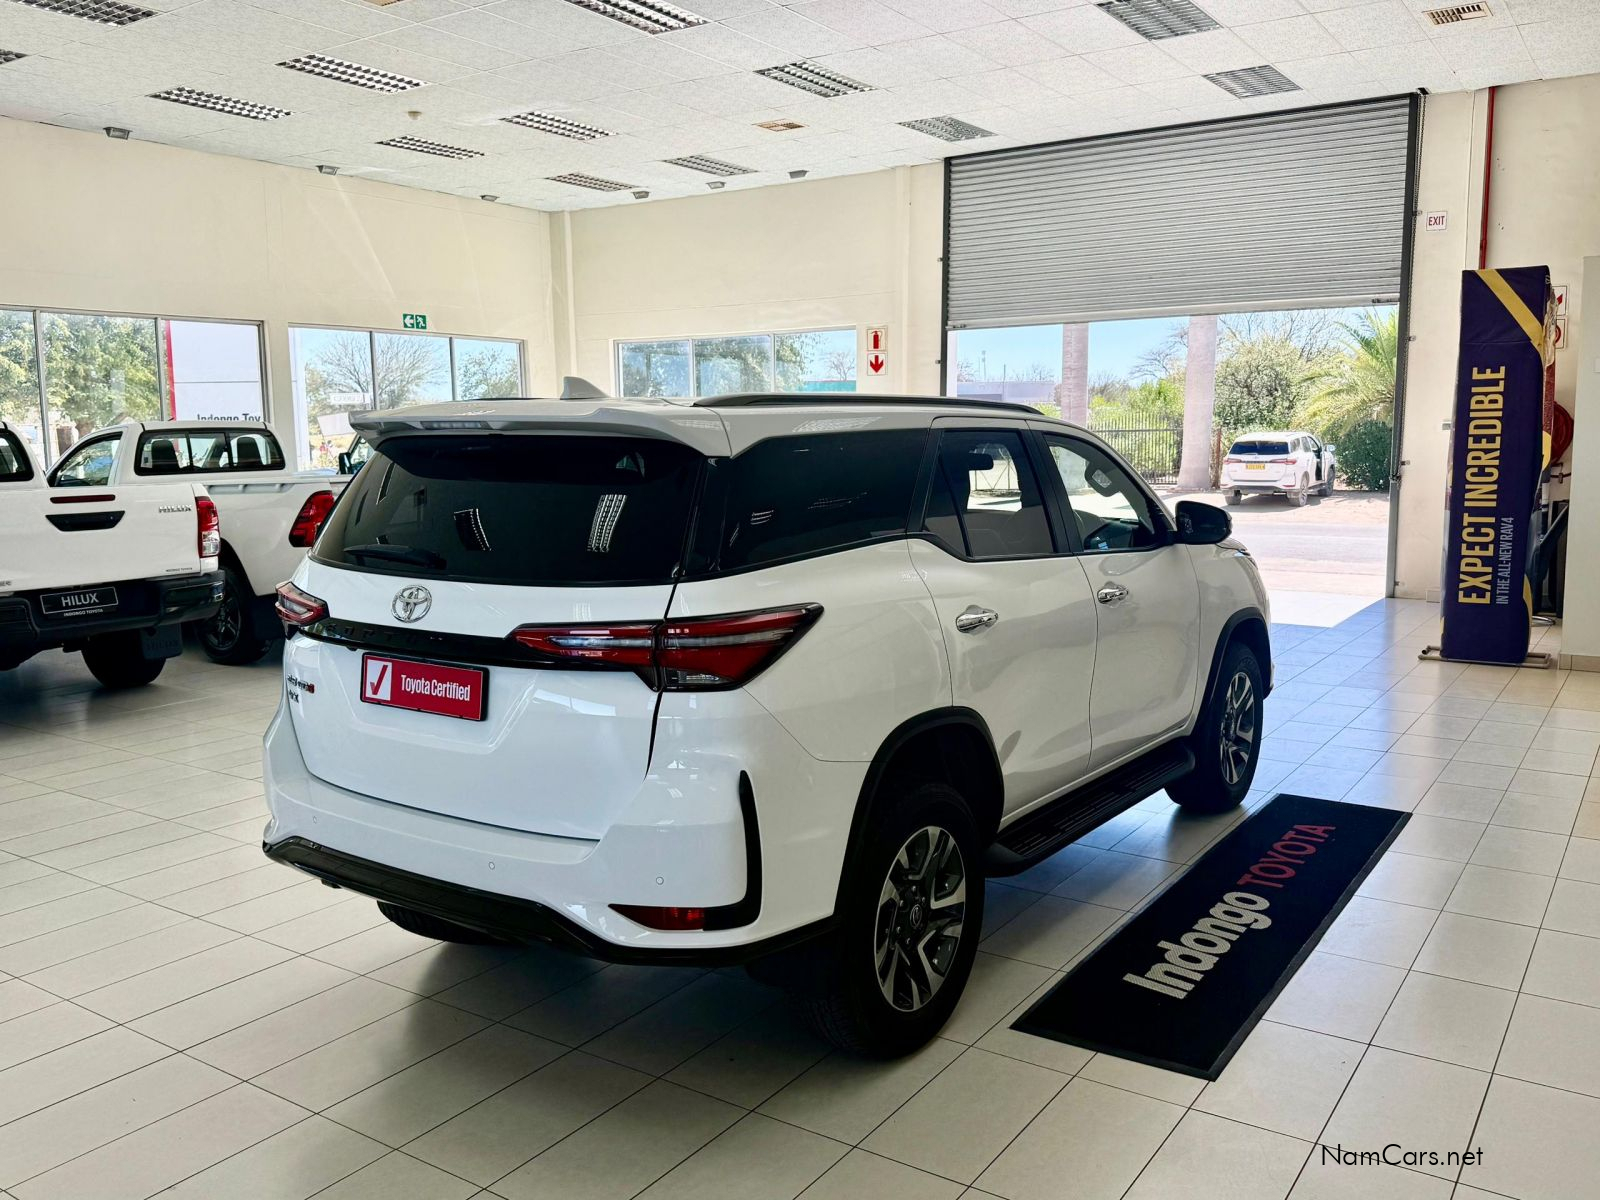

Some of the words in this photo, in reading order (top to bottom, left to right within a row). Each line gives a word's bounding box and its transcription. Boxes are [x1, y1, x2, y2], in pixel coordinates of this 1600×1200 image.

[1428, 215, 1445, 226] EXIT
[1464, 365, 1506, 507] INCREDIBLE
[159, 504, 192, 513] HILUX
[1500, 517, 1514, 541] RAV4
[1458, 512, 1496, 605] EXPECT
[1498, 541, 1513, 578] ALL-NEW
[1496, 578, 1510, 595] THE
[61, 592, 100, 607] HILUX
[1496, 595, 1509, 604] IN
[401, 674, 430, 695] Toyota
[431, 679, 471, 701] Certified
[1122, 891, 1273, 1000] Indongo
[1236, 824, 1336, 889] TOYOTA
